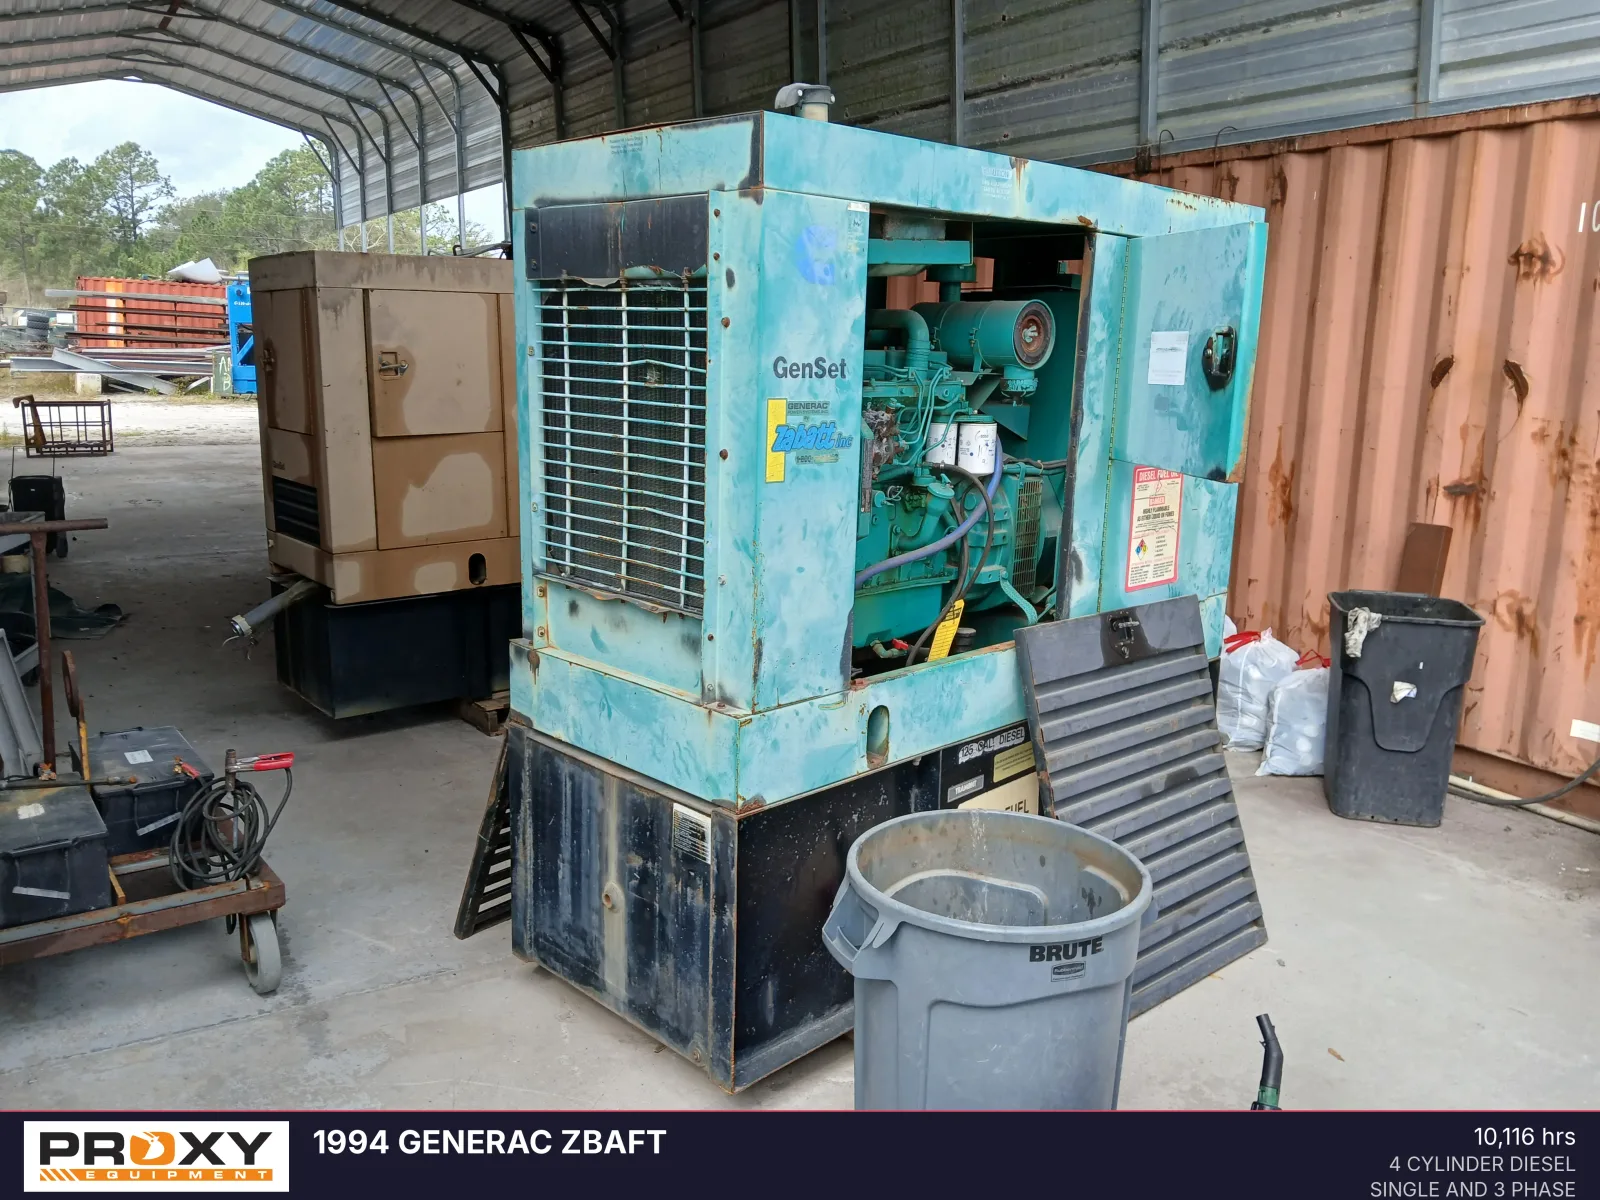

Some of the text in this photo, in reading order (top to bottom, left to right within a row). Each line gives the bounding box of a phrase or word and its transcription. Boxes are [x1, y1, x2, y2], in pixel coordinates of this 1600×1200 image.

[773, 356, 847, 379] GenSet
[787, 402, 829, 410] GENERAC
[1139, 470, 1157, 482] DIESEL
[1157, 469, 1170, 479] FUEL
[998, 728, 1025, 745] DIESEL
[1029, 935, 1103, 962] BRUTE
